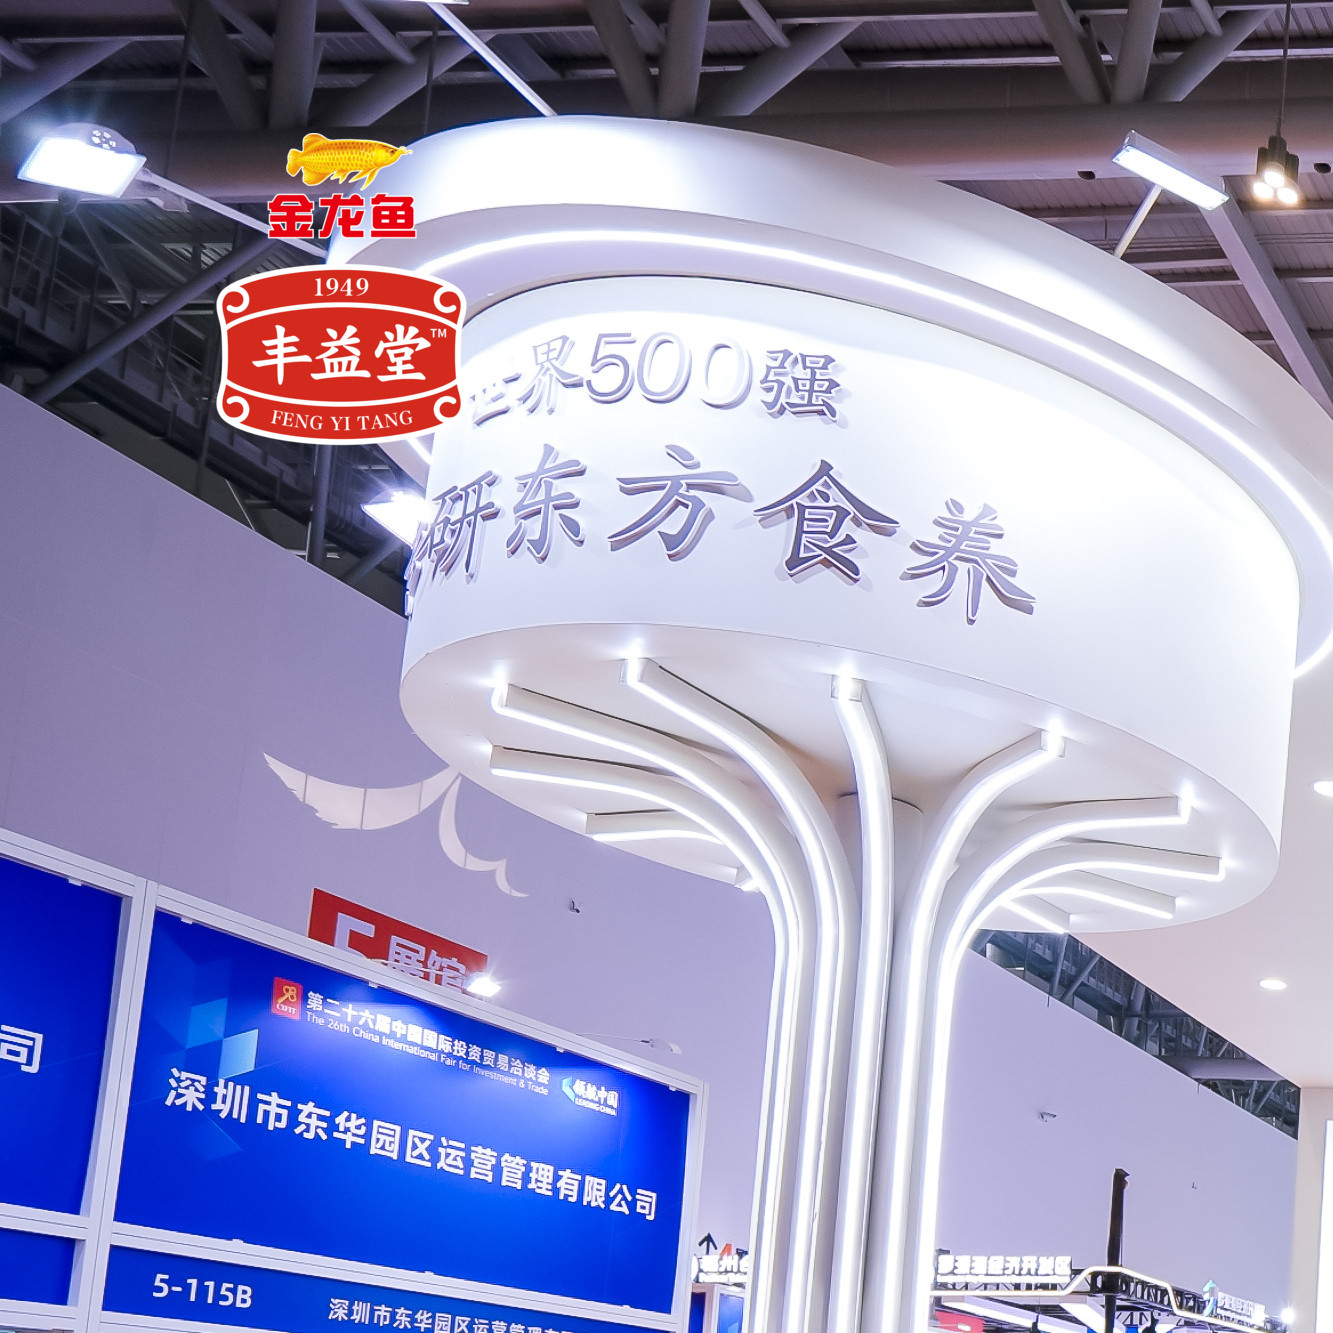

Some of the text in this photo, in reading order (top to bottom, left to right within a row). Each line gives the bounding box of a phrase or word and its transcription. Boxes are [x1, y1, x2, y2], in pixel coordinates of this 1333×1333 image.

[471, 332, 841, 426] 世界500强
[405, 443, 1036, 622] 研东方食养
[306, 1011, 325, 1027] The
[327, 1017, 350, 1033] 26th
[352, 1024, 380, 1043] China
[381, 1034, 438, 1064] International
[440, 1052, 457, 1068] Fair
[473, 1063, 517, 1087] Investment
[527, 1081, 549, 1096] Trade
[307, 990, 550, 1085] 第二十六届中国国际投资贸易洽谈会
[165, 1067, 658, 1221] 深圳市东华园区运营管理有限公司
[153, 1274, 252, 1309] 5-115B
